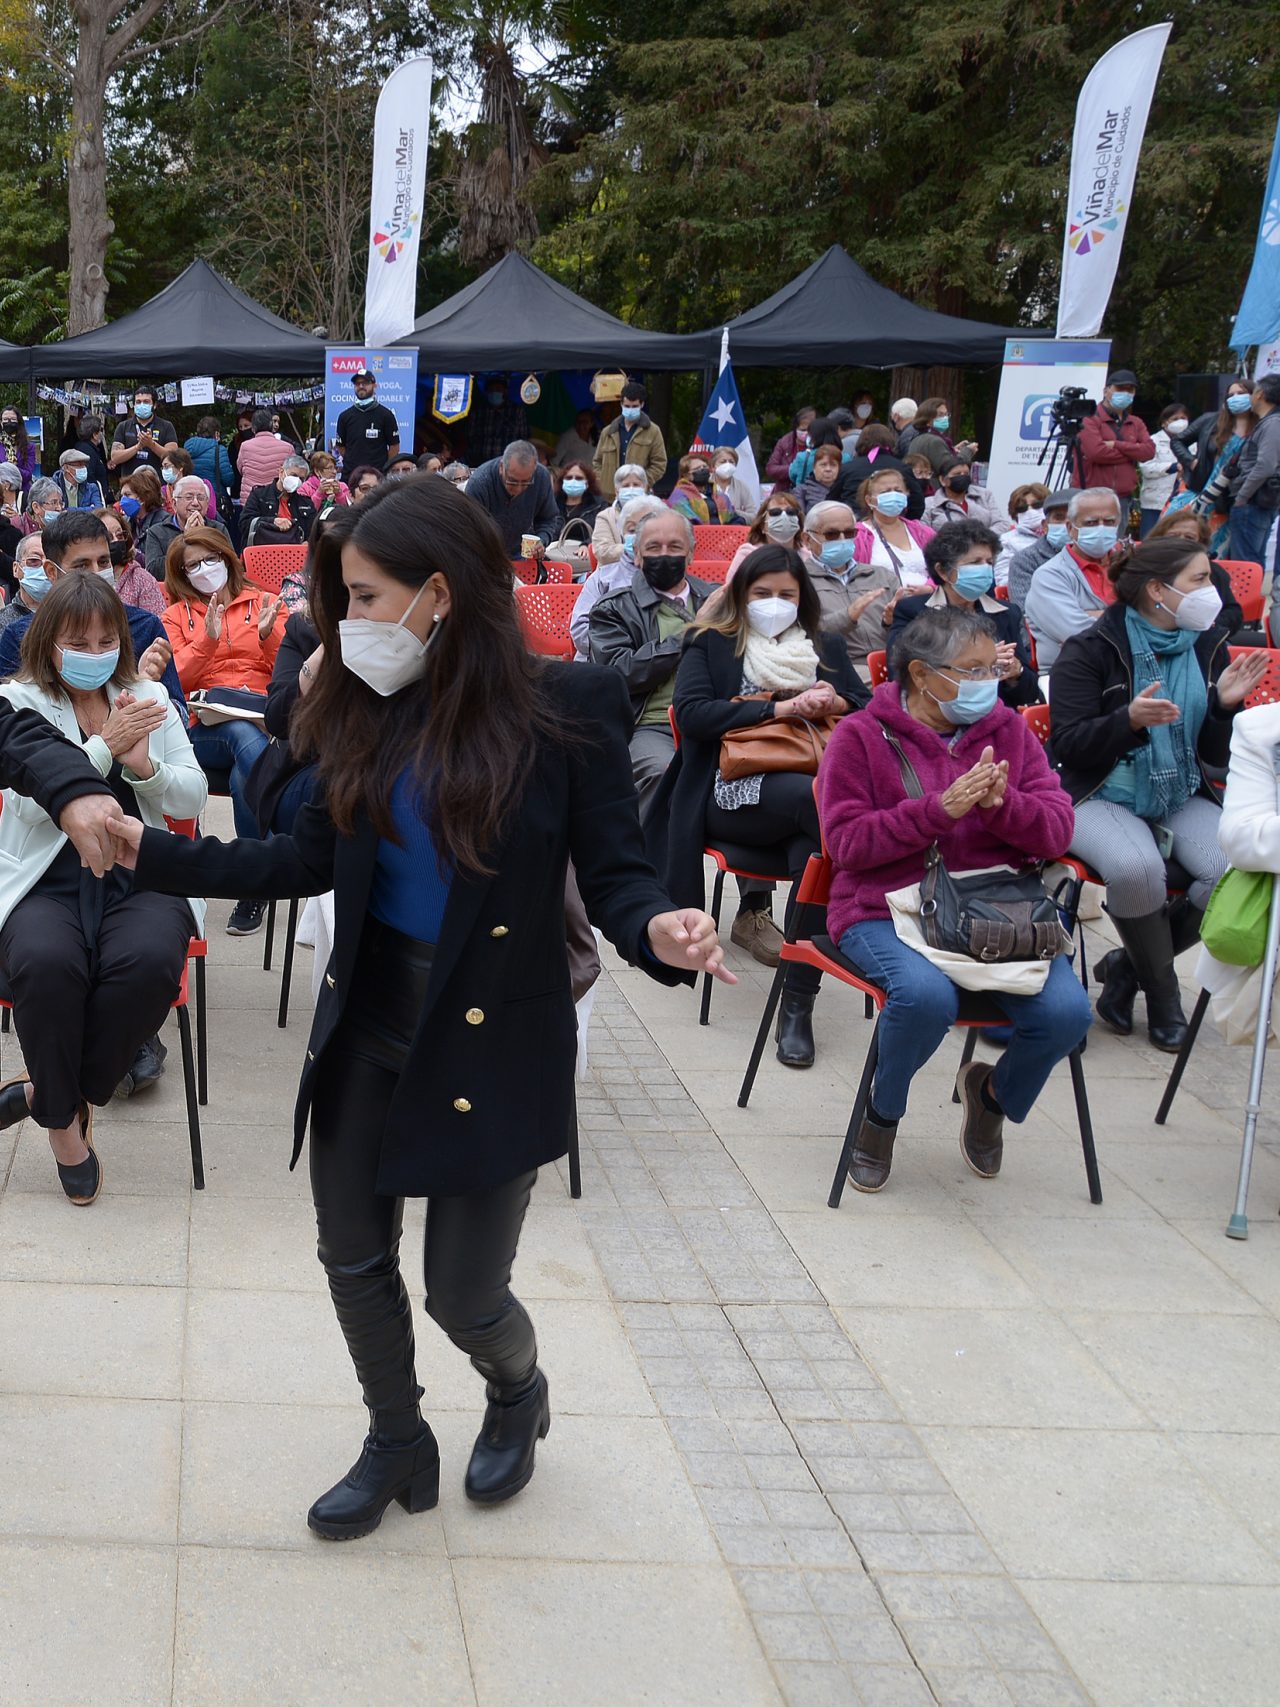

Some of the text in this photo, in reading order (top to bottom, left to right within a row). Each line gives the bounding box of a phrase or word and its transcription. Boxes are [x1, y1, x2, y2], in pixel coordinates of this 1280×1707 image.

[406, 172, 412, 185] de
[1082, 109, 1119, 226] ViñadelMar
[1103, 105, 1132, 218] Municipio de Cuidados
